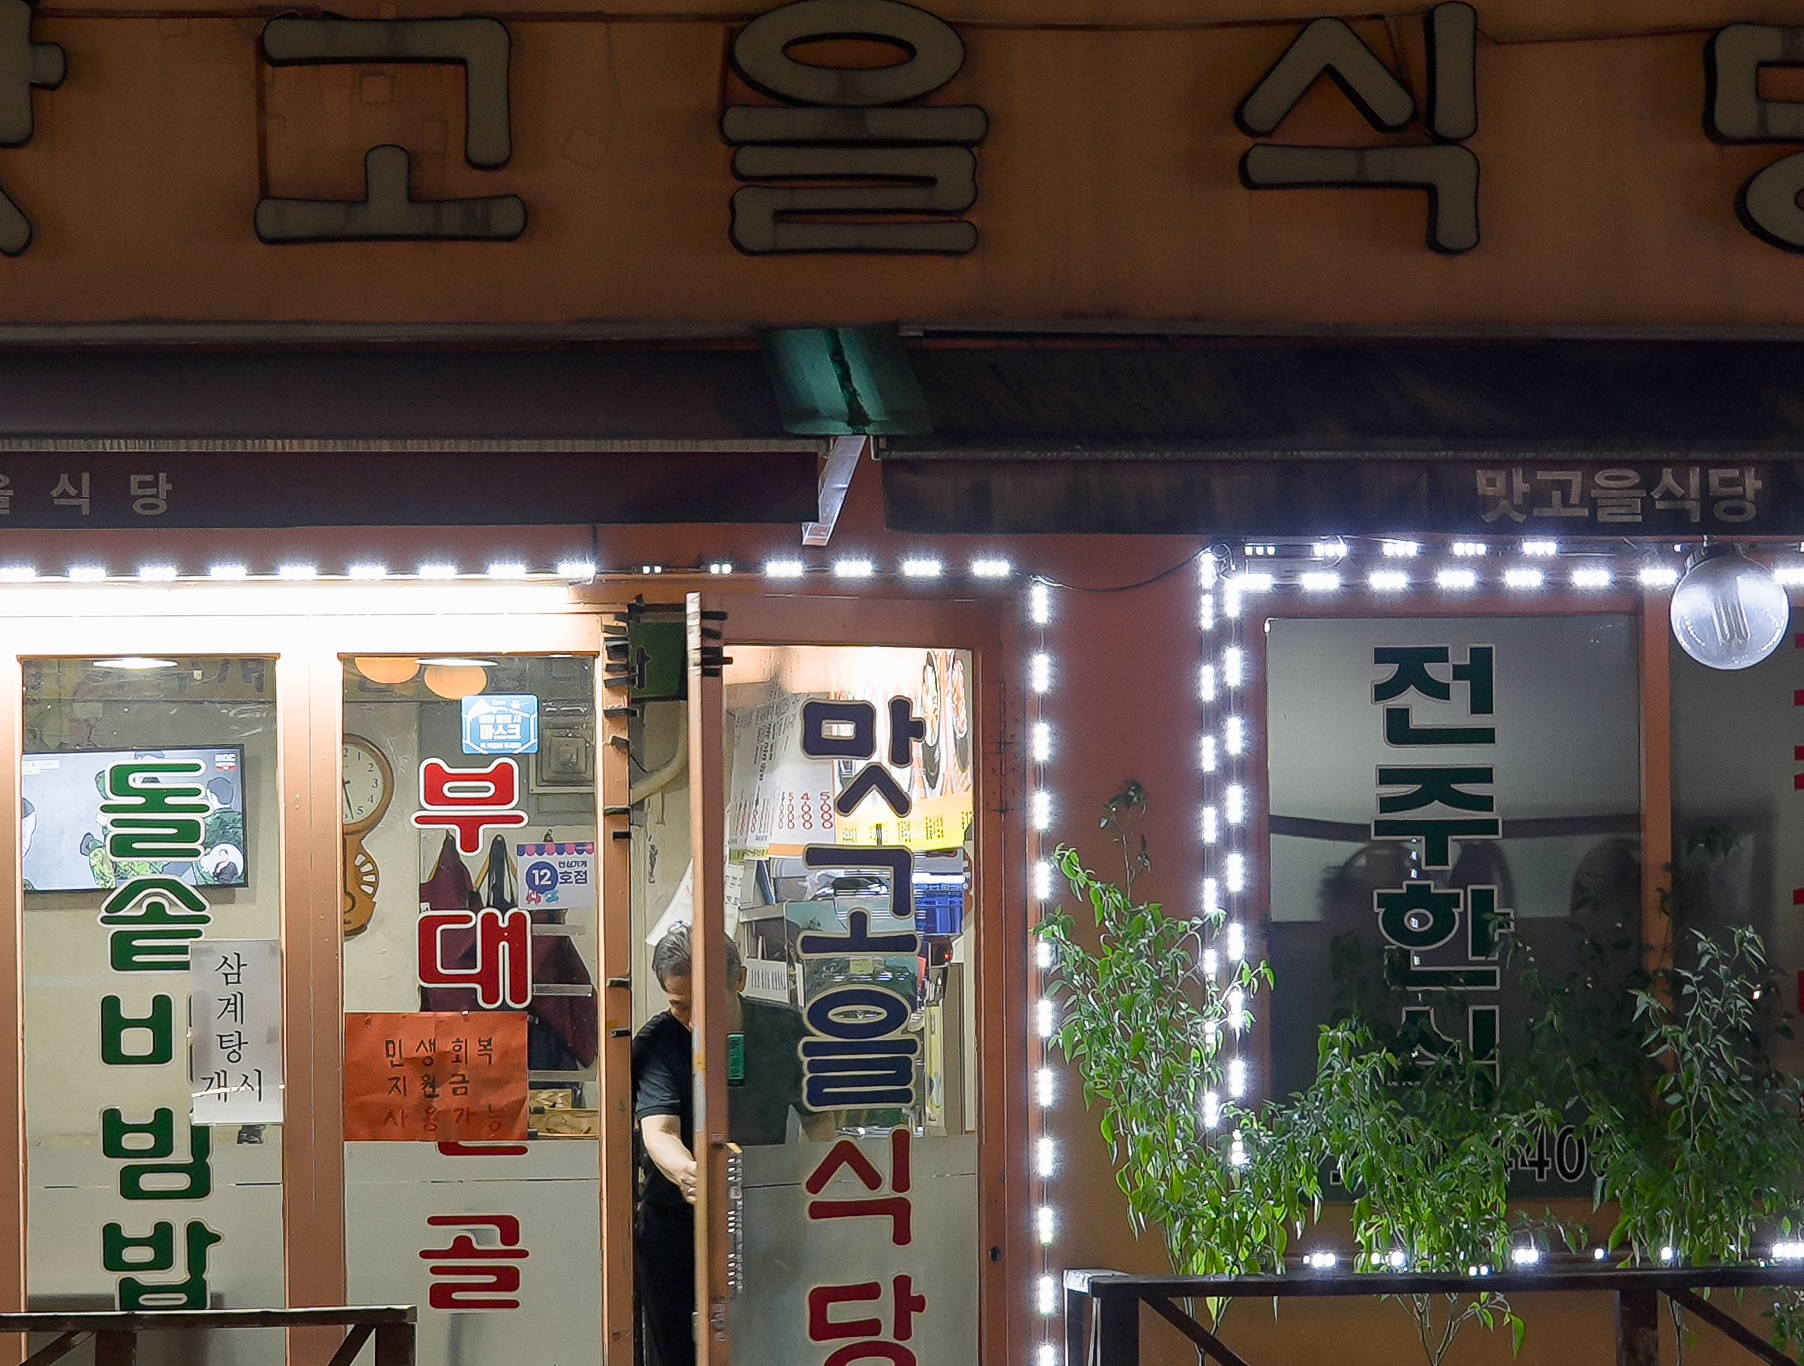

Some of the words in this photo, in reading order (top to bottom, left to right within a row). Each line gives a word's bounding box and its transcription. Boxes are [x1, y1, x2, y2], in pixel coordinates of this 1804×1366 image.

[1476, 467, 1762, 523] 맛고을식당
[368, 763, 374, 772] 2
[372, 778, 378, 788] 3
[357, 806, 363, 815] 5
[368, 795, 374, 803] 4
[214, 951, 249, 1064] 삼계탕
[413, 757, 530, 1310] 부대골
[384, 1037, 493, 1068] 민생회복
[201, 1068, 262, 1103] 개시
[387, 1073, 470, 1098] 지원금
